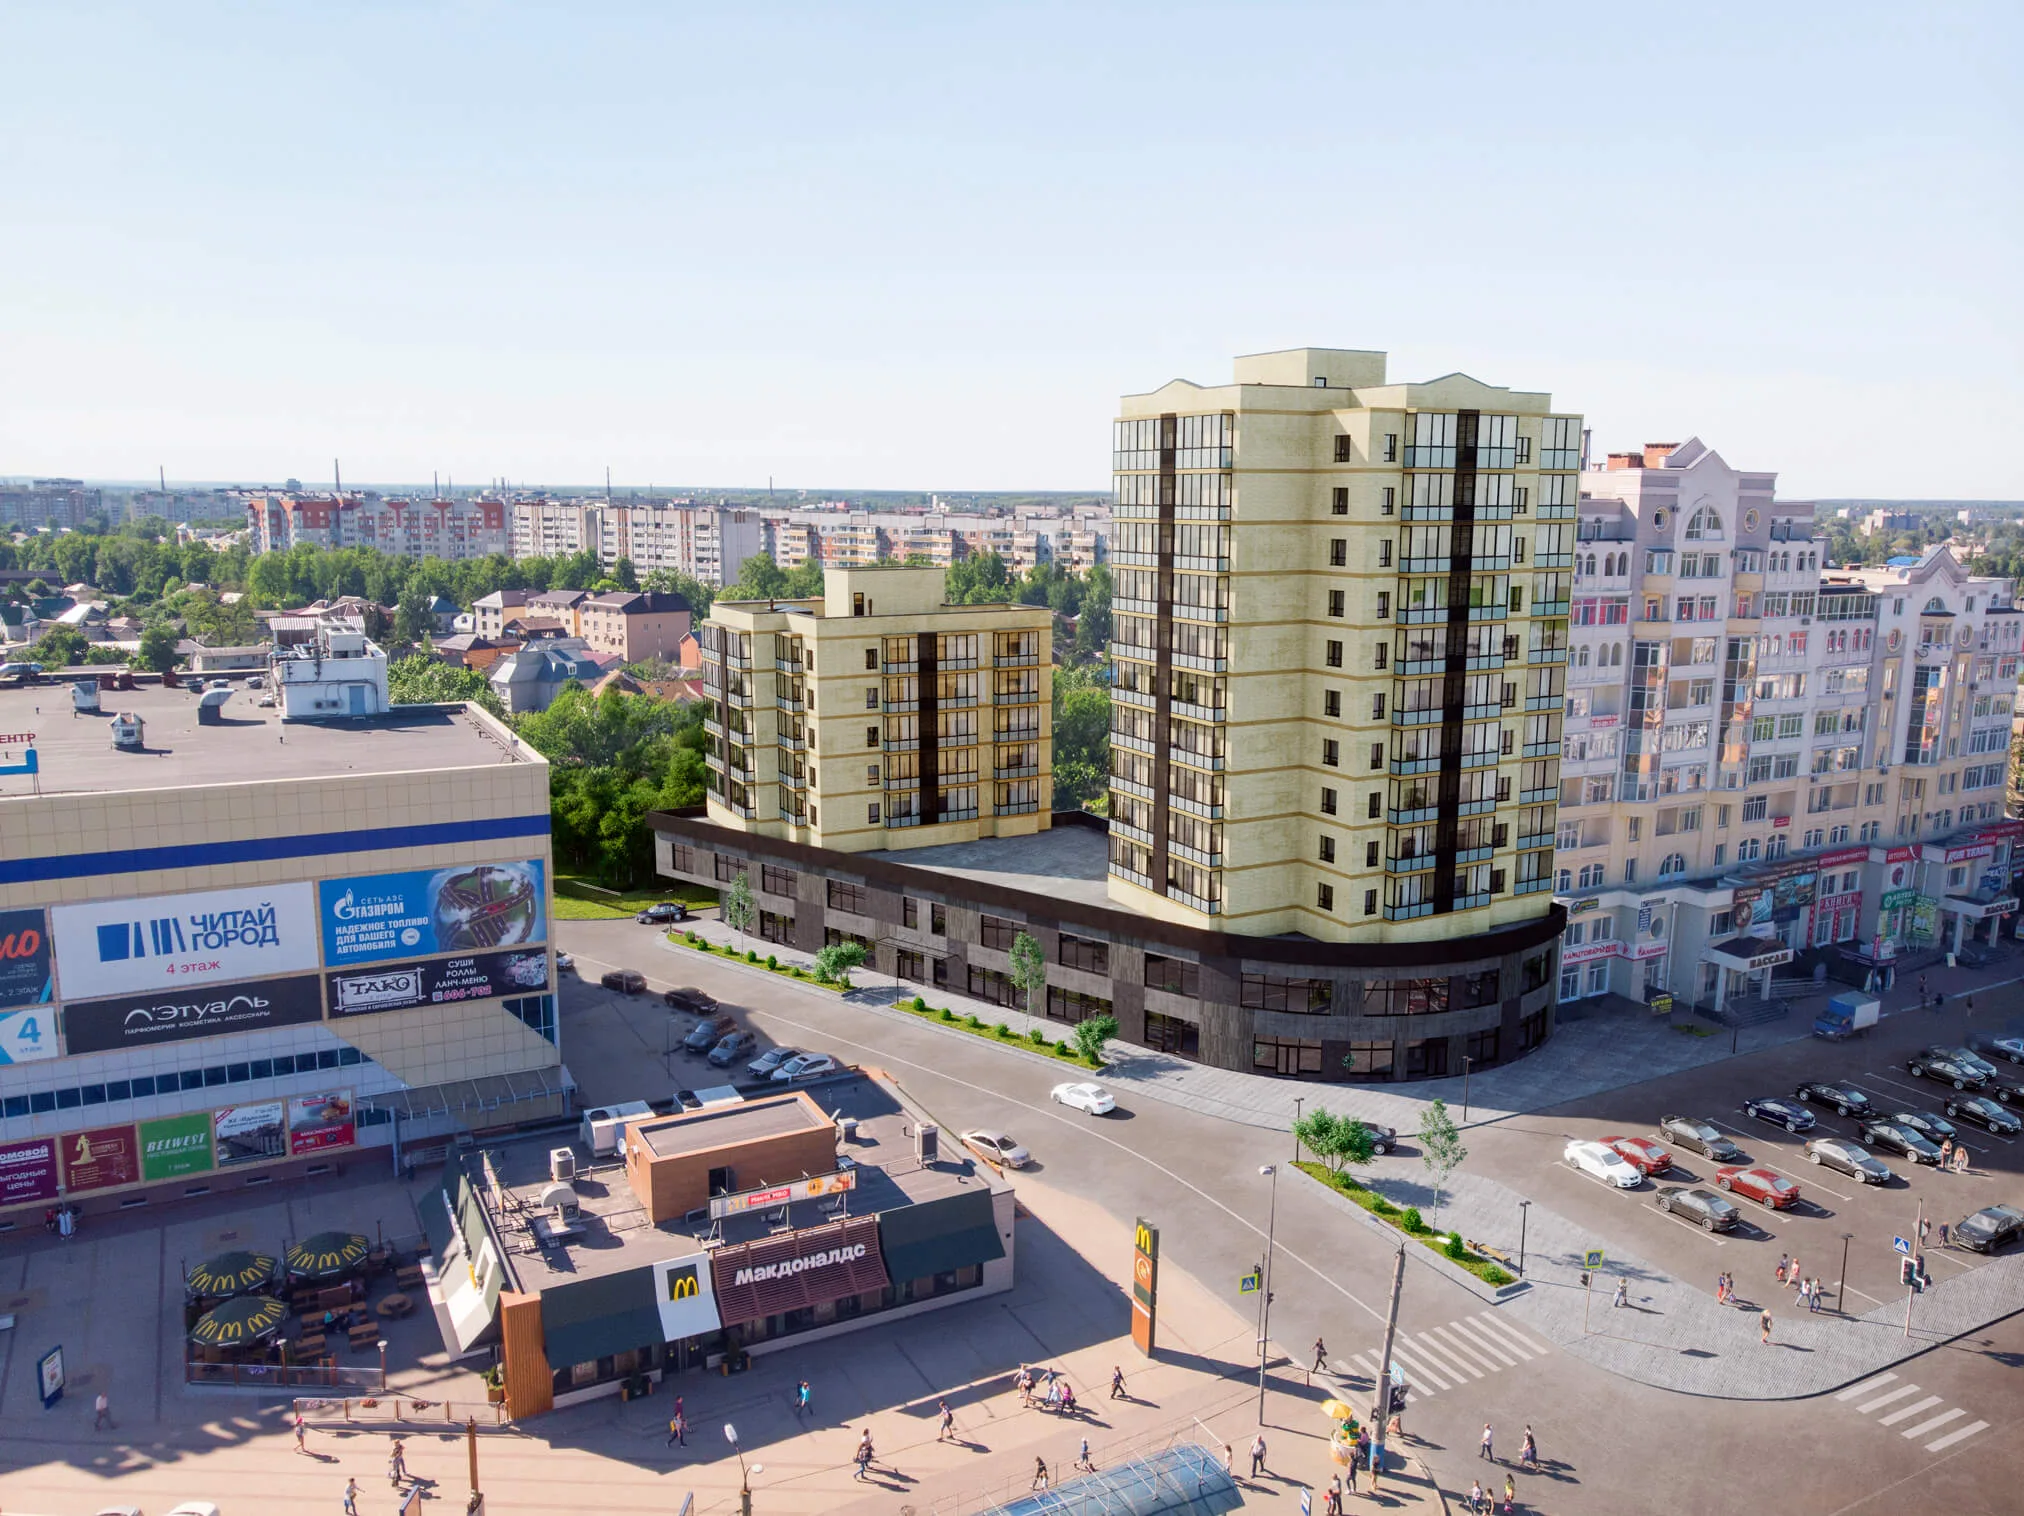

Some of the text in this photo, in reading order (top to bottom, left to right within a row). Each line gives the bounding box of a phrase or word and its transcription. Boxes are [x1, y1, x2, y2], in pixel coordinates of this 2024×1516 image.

[361, 894, 404, 905] СЕТЬ АЗС
[190, 902, 277, 932] ЧИТАЙ
[354, 902, 405, 919] ГАЗПРОМ
[335, 916, 429, 936] НАДЕЖНОЕ ТОПЛИВО
[191, 924, 280, 951] ГОРОД
[336, 934, 357, 946] ДЛЯ
[358, 930, 396, 942] ВАШЕГО
[336, 939, 397, 955] АВТОМОБИЛЯ
[166, 959, 222, 975] 4 этаж
[448, 958, 475, 968] СУШИ
[446, 967, 477, 978] РОЛЛЫ
[349, 975, 411, 997] ТАКО
[435, 975, 489, 989] ЛАНЧ-МЕНЮ
[17, 1016, 42, 1044] 4
[179, 1016, 222, 1028] КОСМЕТИКА
[146, 1132, 207, 1153] BELWEST
[734, 1242, 867, 1287] Макдоналдс
